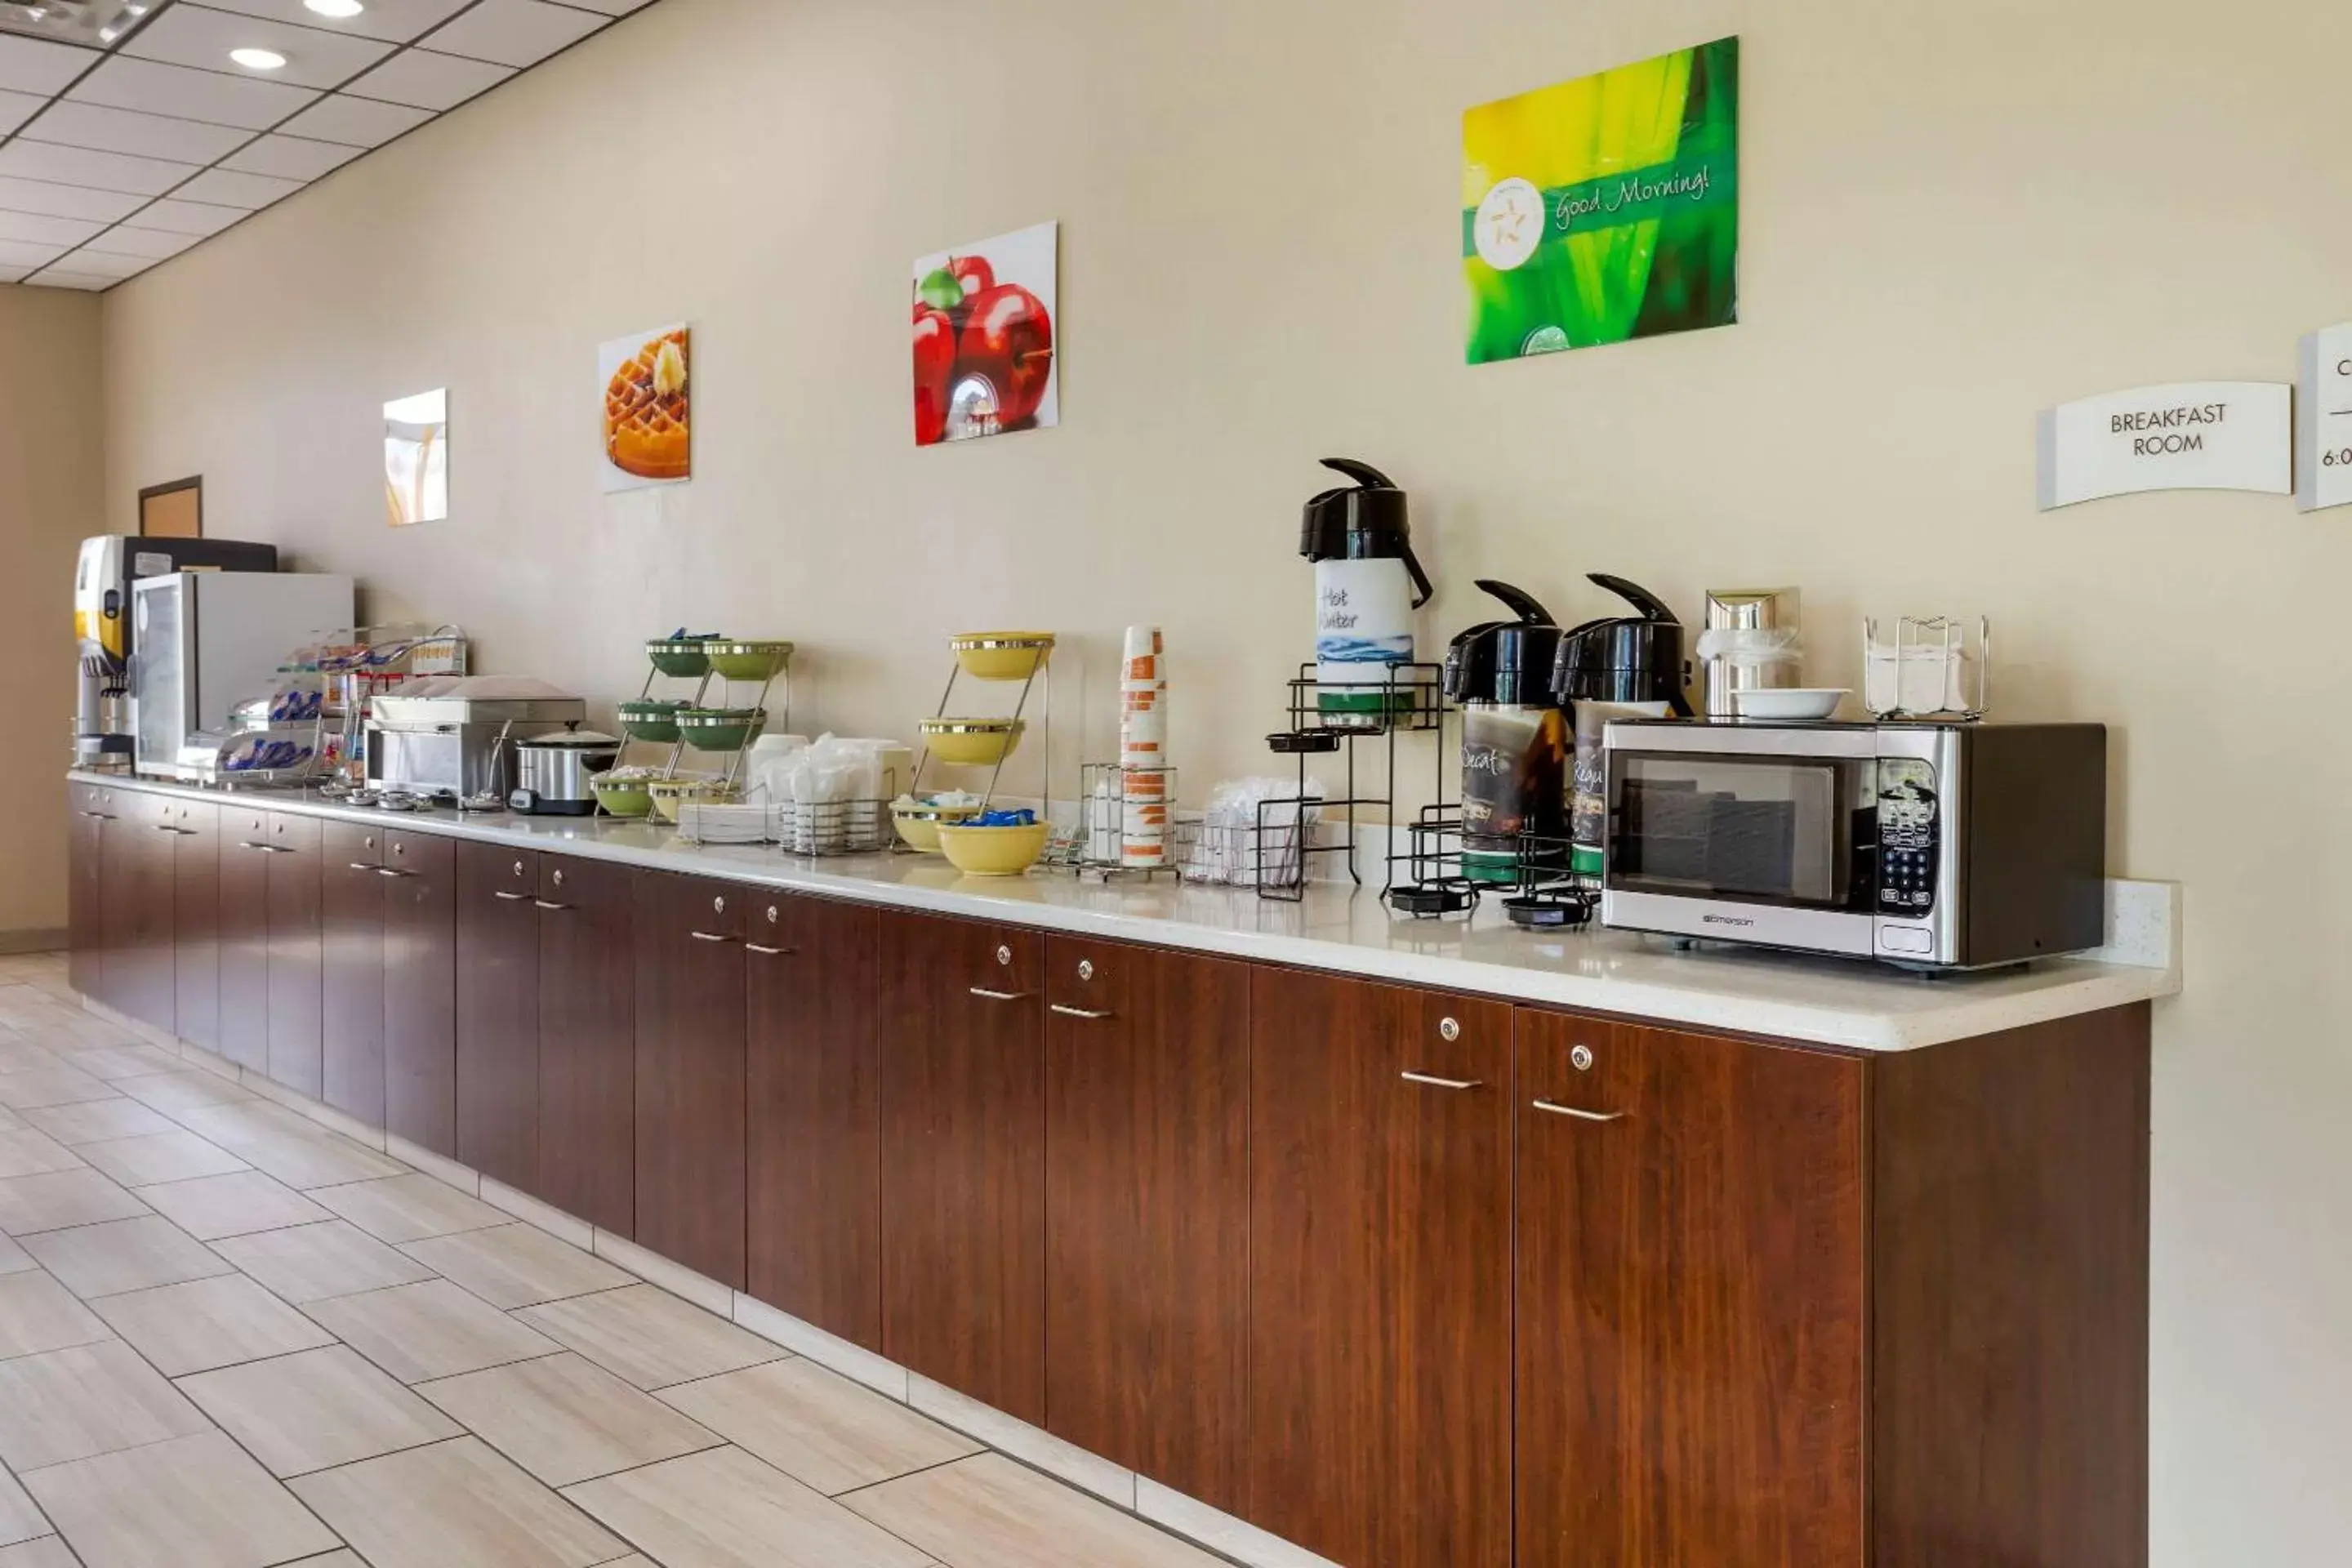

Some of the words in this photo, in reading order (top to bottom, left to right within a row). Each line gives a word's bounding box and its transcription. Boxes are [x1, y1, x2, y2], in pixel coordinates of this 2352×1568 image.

[1557, 188, 1601, 230] Good
[1606, 165, 1709, 212] Morning!
[2111, 403, 2227, 433] BREAKFAST
[2134, 433, 2203, 456] ROOM
[1321, 586, 1348, 609] Hot
